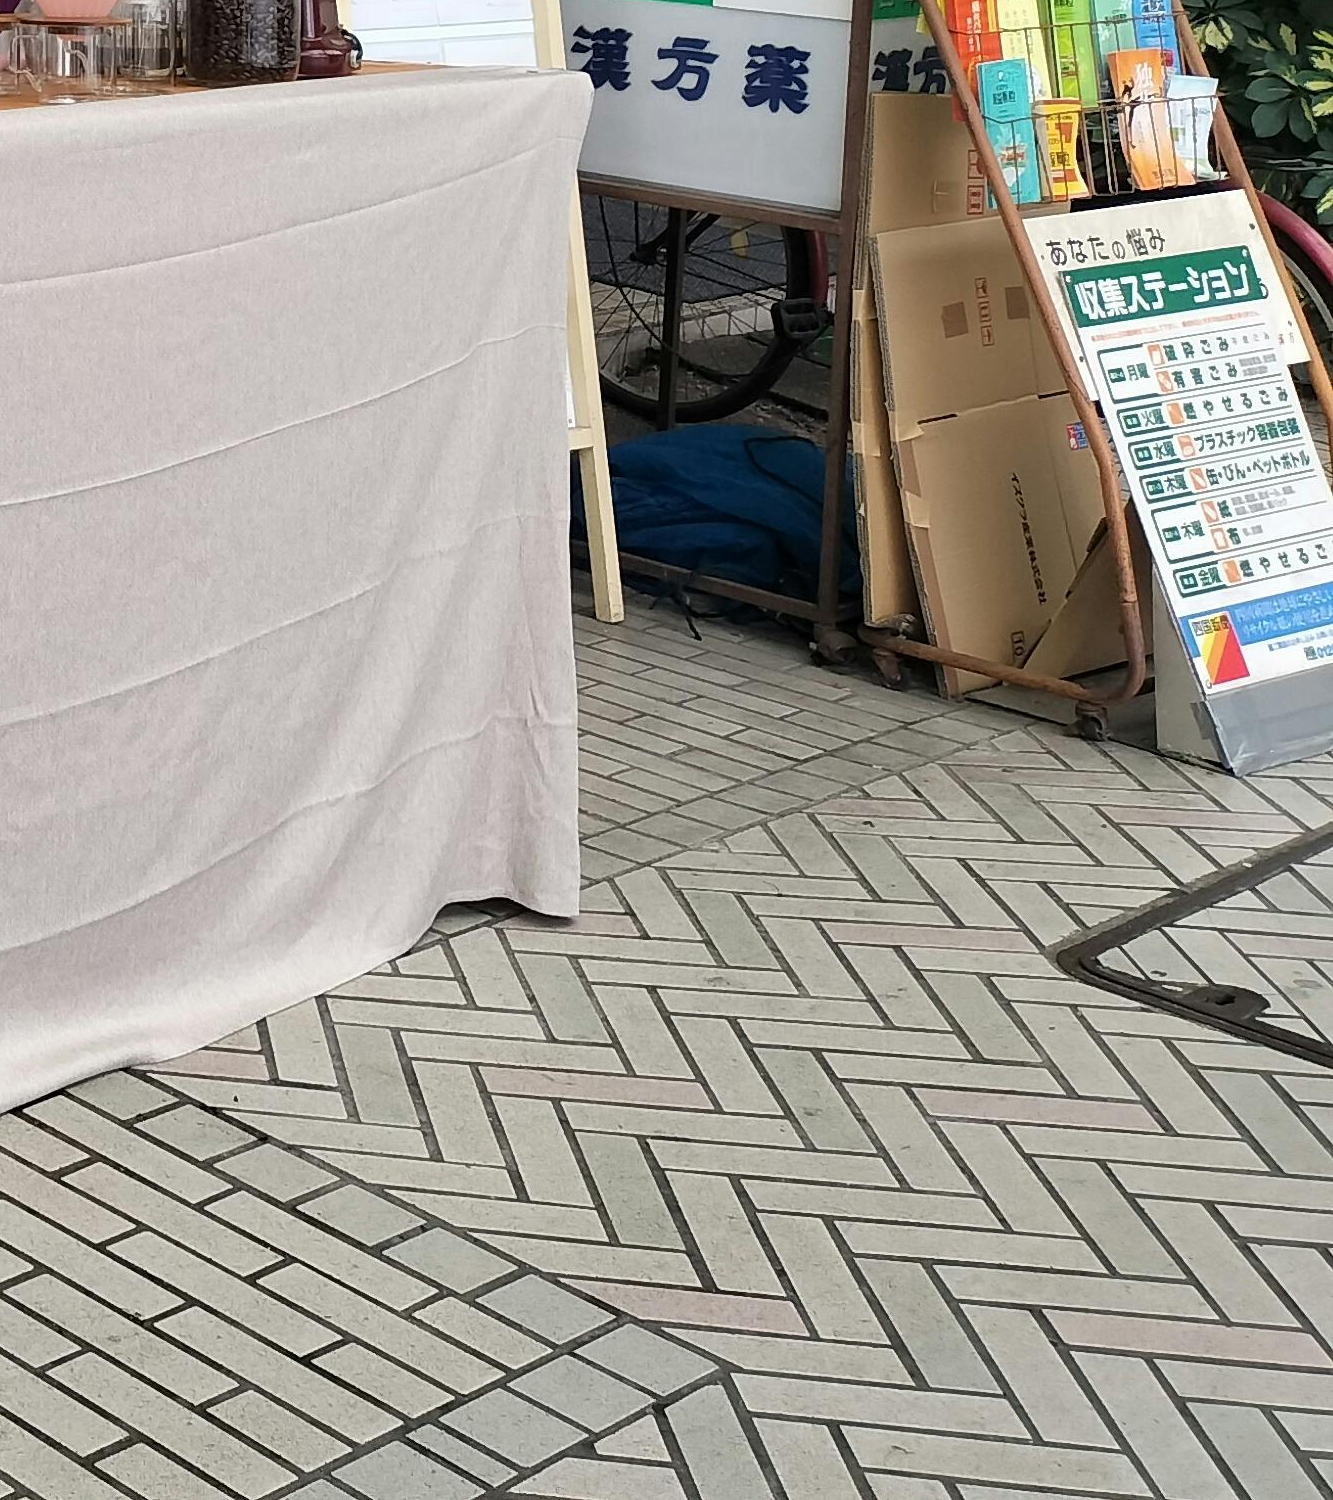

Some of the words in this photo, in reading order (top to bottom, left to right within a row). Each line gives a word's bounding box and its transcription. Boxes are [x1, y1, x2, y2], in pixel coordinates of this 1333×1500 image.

[570, 25, 811, 115] 漢方薬
[1046, 228, 1165, 266] あなたの悩み
[1073, 260, 1250, 320] 収集ステーション
[1183, 386, 1289, 420] 燃やせるごみ
[1194, 417, 1301, 452] プラスチック容器包装
[1239, 539, 1333, 578] 燃やせるご
